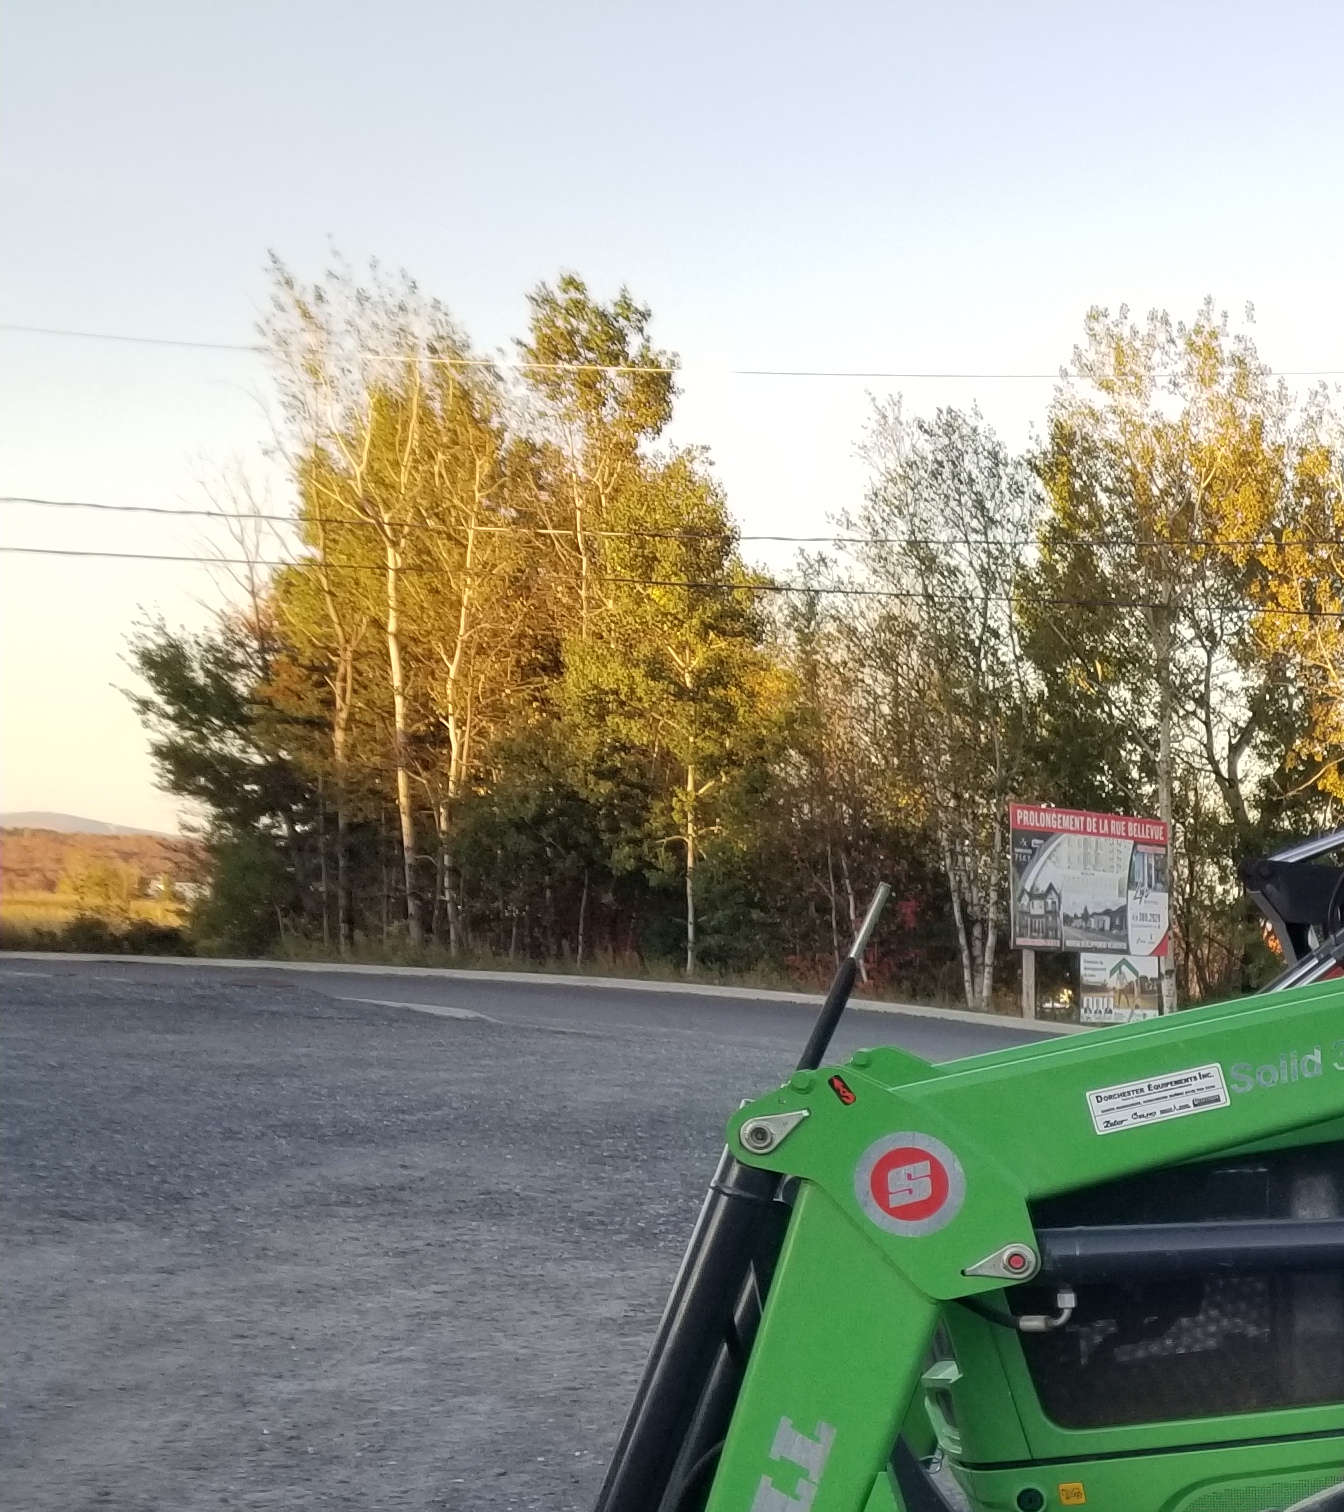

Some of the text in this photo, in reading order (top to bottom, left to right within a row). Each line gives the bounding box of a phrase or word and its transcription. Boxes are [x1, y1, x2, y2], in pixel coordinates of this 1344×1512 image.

[1016, 809, 1165, 840] PROLONGEMENT DE LA RUE BELLEVUE
[1230, 1045, 1323, 1093] Solid
